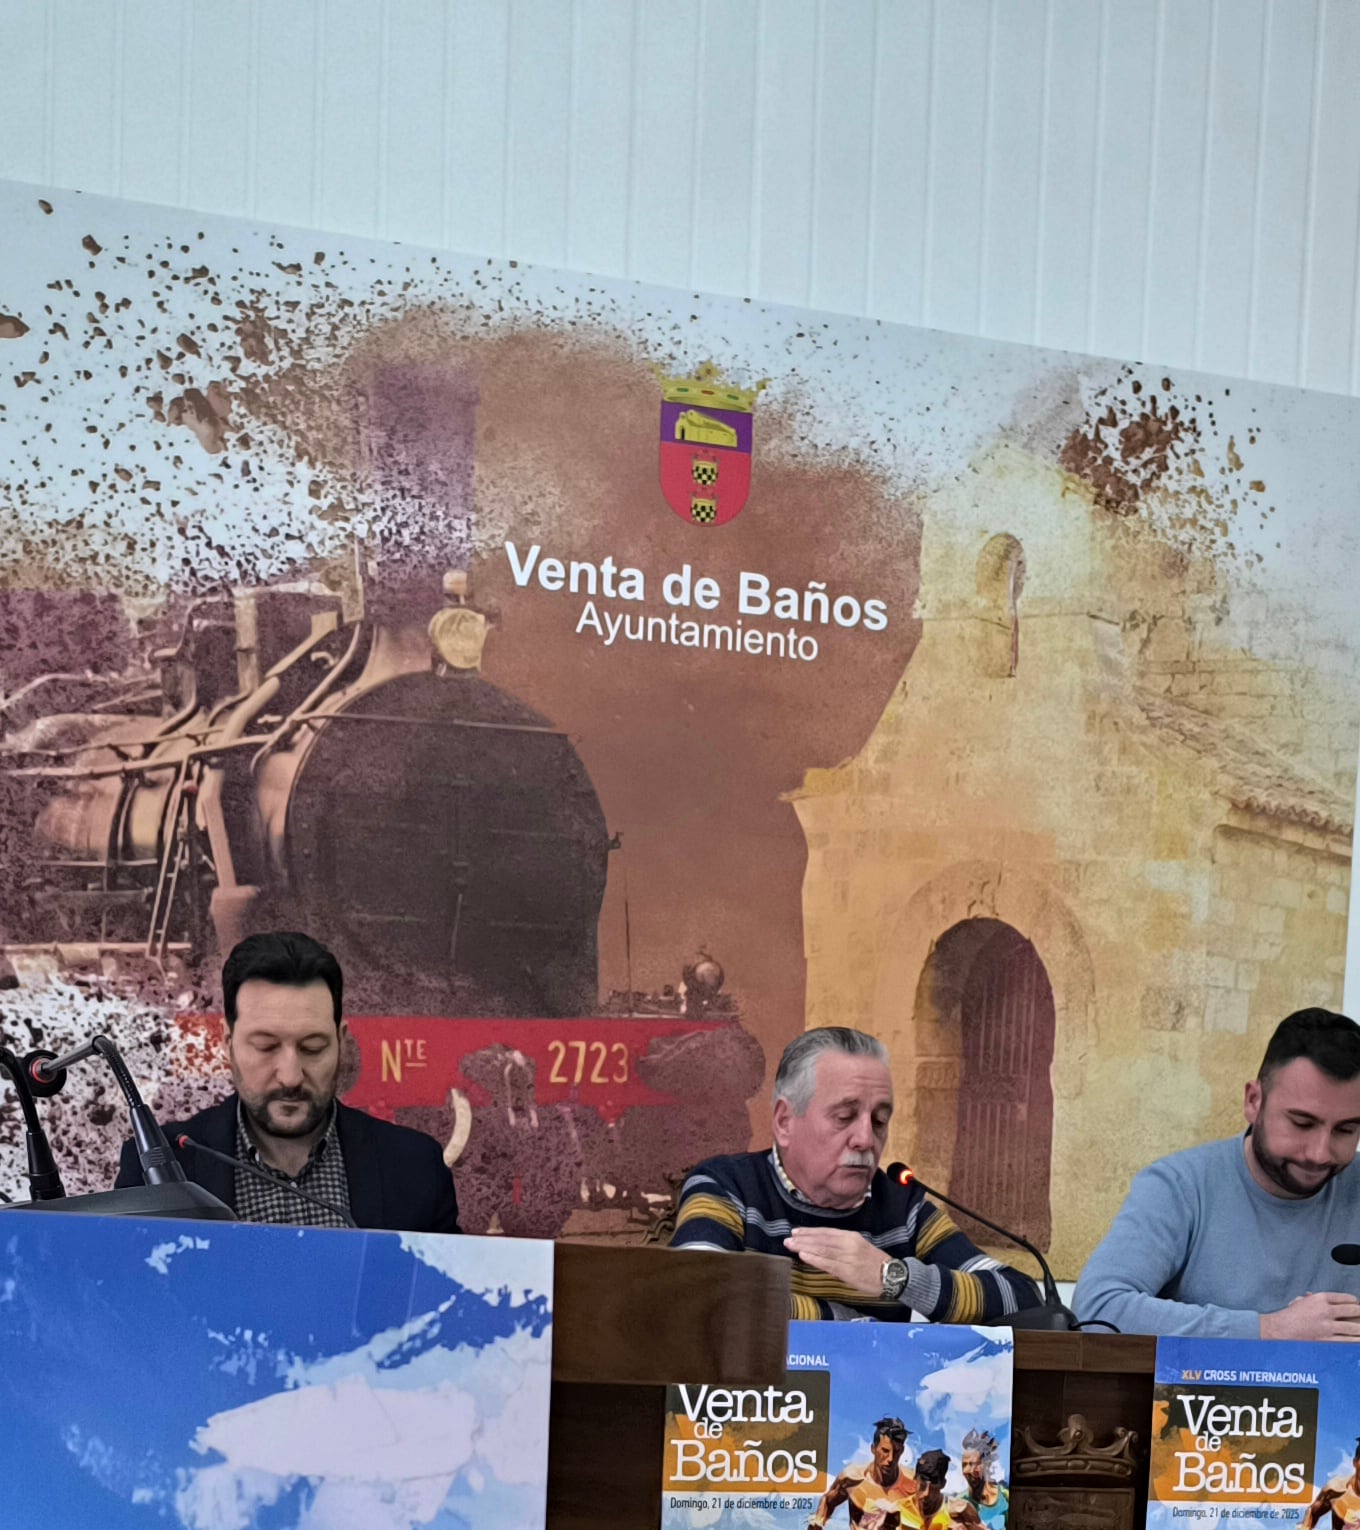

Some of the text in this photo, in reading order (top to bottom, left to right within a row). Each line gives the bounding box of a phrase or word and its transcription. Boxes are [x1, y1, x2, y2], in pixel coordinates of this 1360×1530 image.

[505, 541, 889, 631] Venta de Baños
[575, 601, 819, 662] Ayuntamiento
[548, 1040, 629, 1083] 2723
[1182, 1370, 1319, 1385] XLV CROSS INTERNACIONAL
[676, 1384, 814, 1424] Venta
[1177, 1394, 1303, 1438] Venta
[693, 1417, 723, 1439] de
[1195, 1431, 1222, 1453] de
[669, 1439, 818, 1483] Baños
[1172, 1451, 1305, 1495] Baños
[670, 1497, 813, 1511] Domingo, 21 de diciembre de 2025
[1209, 1507, 1219, 1518] 21
[1220, 1507, 1230, 1518] de
[1231, 1507, 1269, 1519] diciembre
